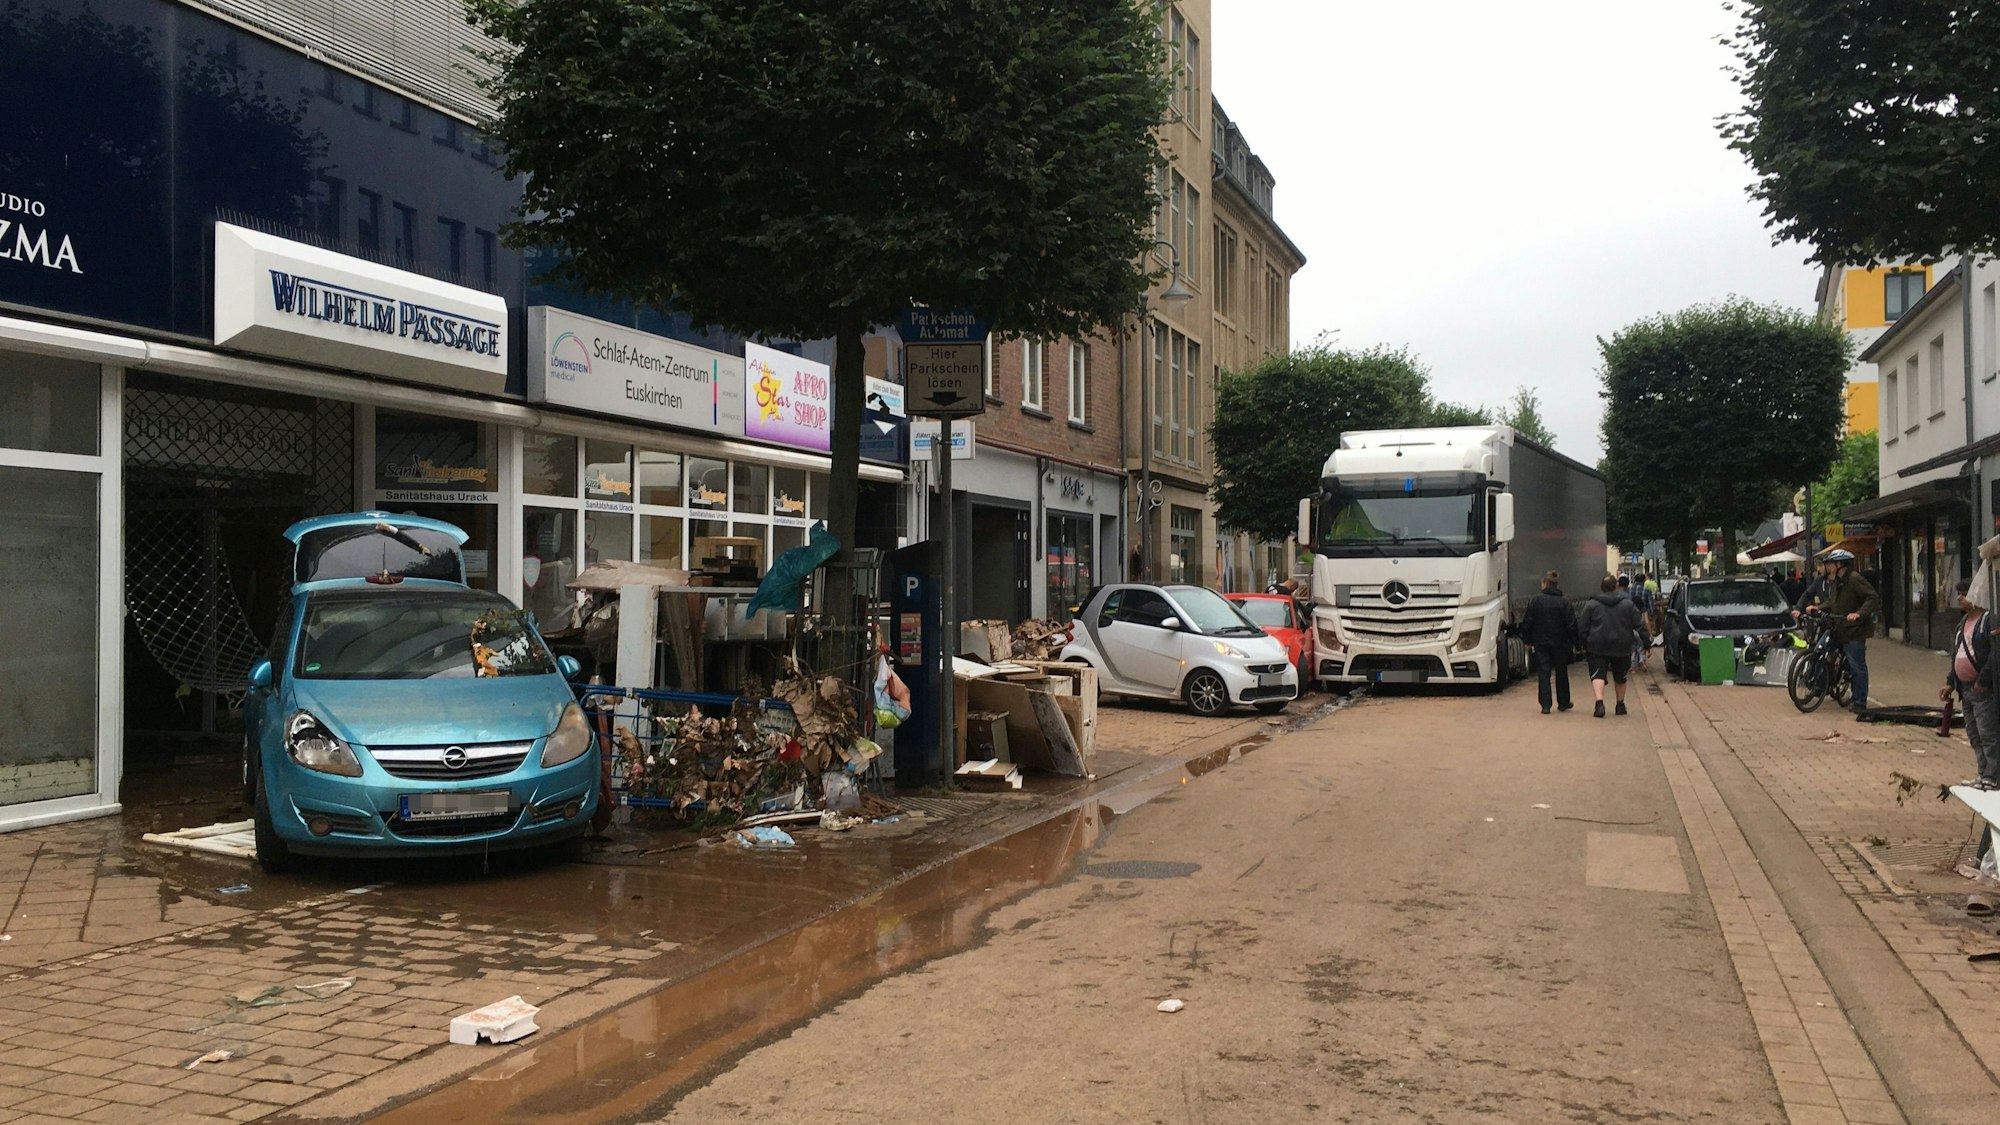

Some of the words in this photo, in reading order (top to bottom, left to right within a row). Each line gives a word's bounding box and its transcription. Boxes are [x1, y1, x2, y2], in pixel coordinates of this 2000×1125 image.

[269, 269, 396, 335] WILHELM
[399, 300, 500, 357] PASSAGE
[593, 337, 709, 384] Schlaf-Atem-Zentrum
[931, 348, 957, 359] Hier
[550, 357, 588, 374] LÖWENSTEIN
[910, 363, 979, 374] Parkschein
[550, 370, 576, 382] medical
[793, 371, 827, 400] AFRO
[928, 376, 962, 389] lösen
[625, 379, 682, 409] Euskirchen
[756, 376, 791, 408] Star
[794, 401, 827, 430] SHOP
[457, 492, 489, 502] Urack
[906, 577, 919, 597] P
